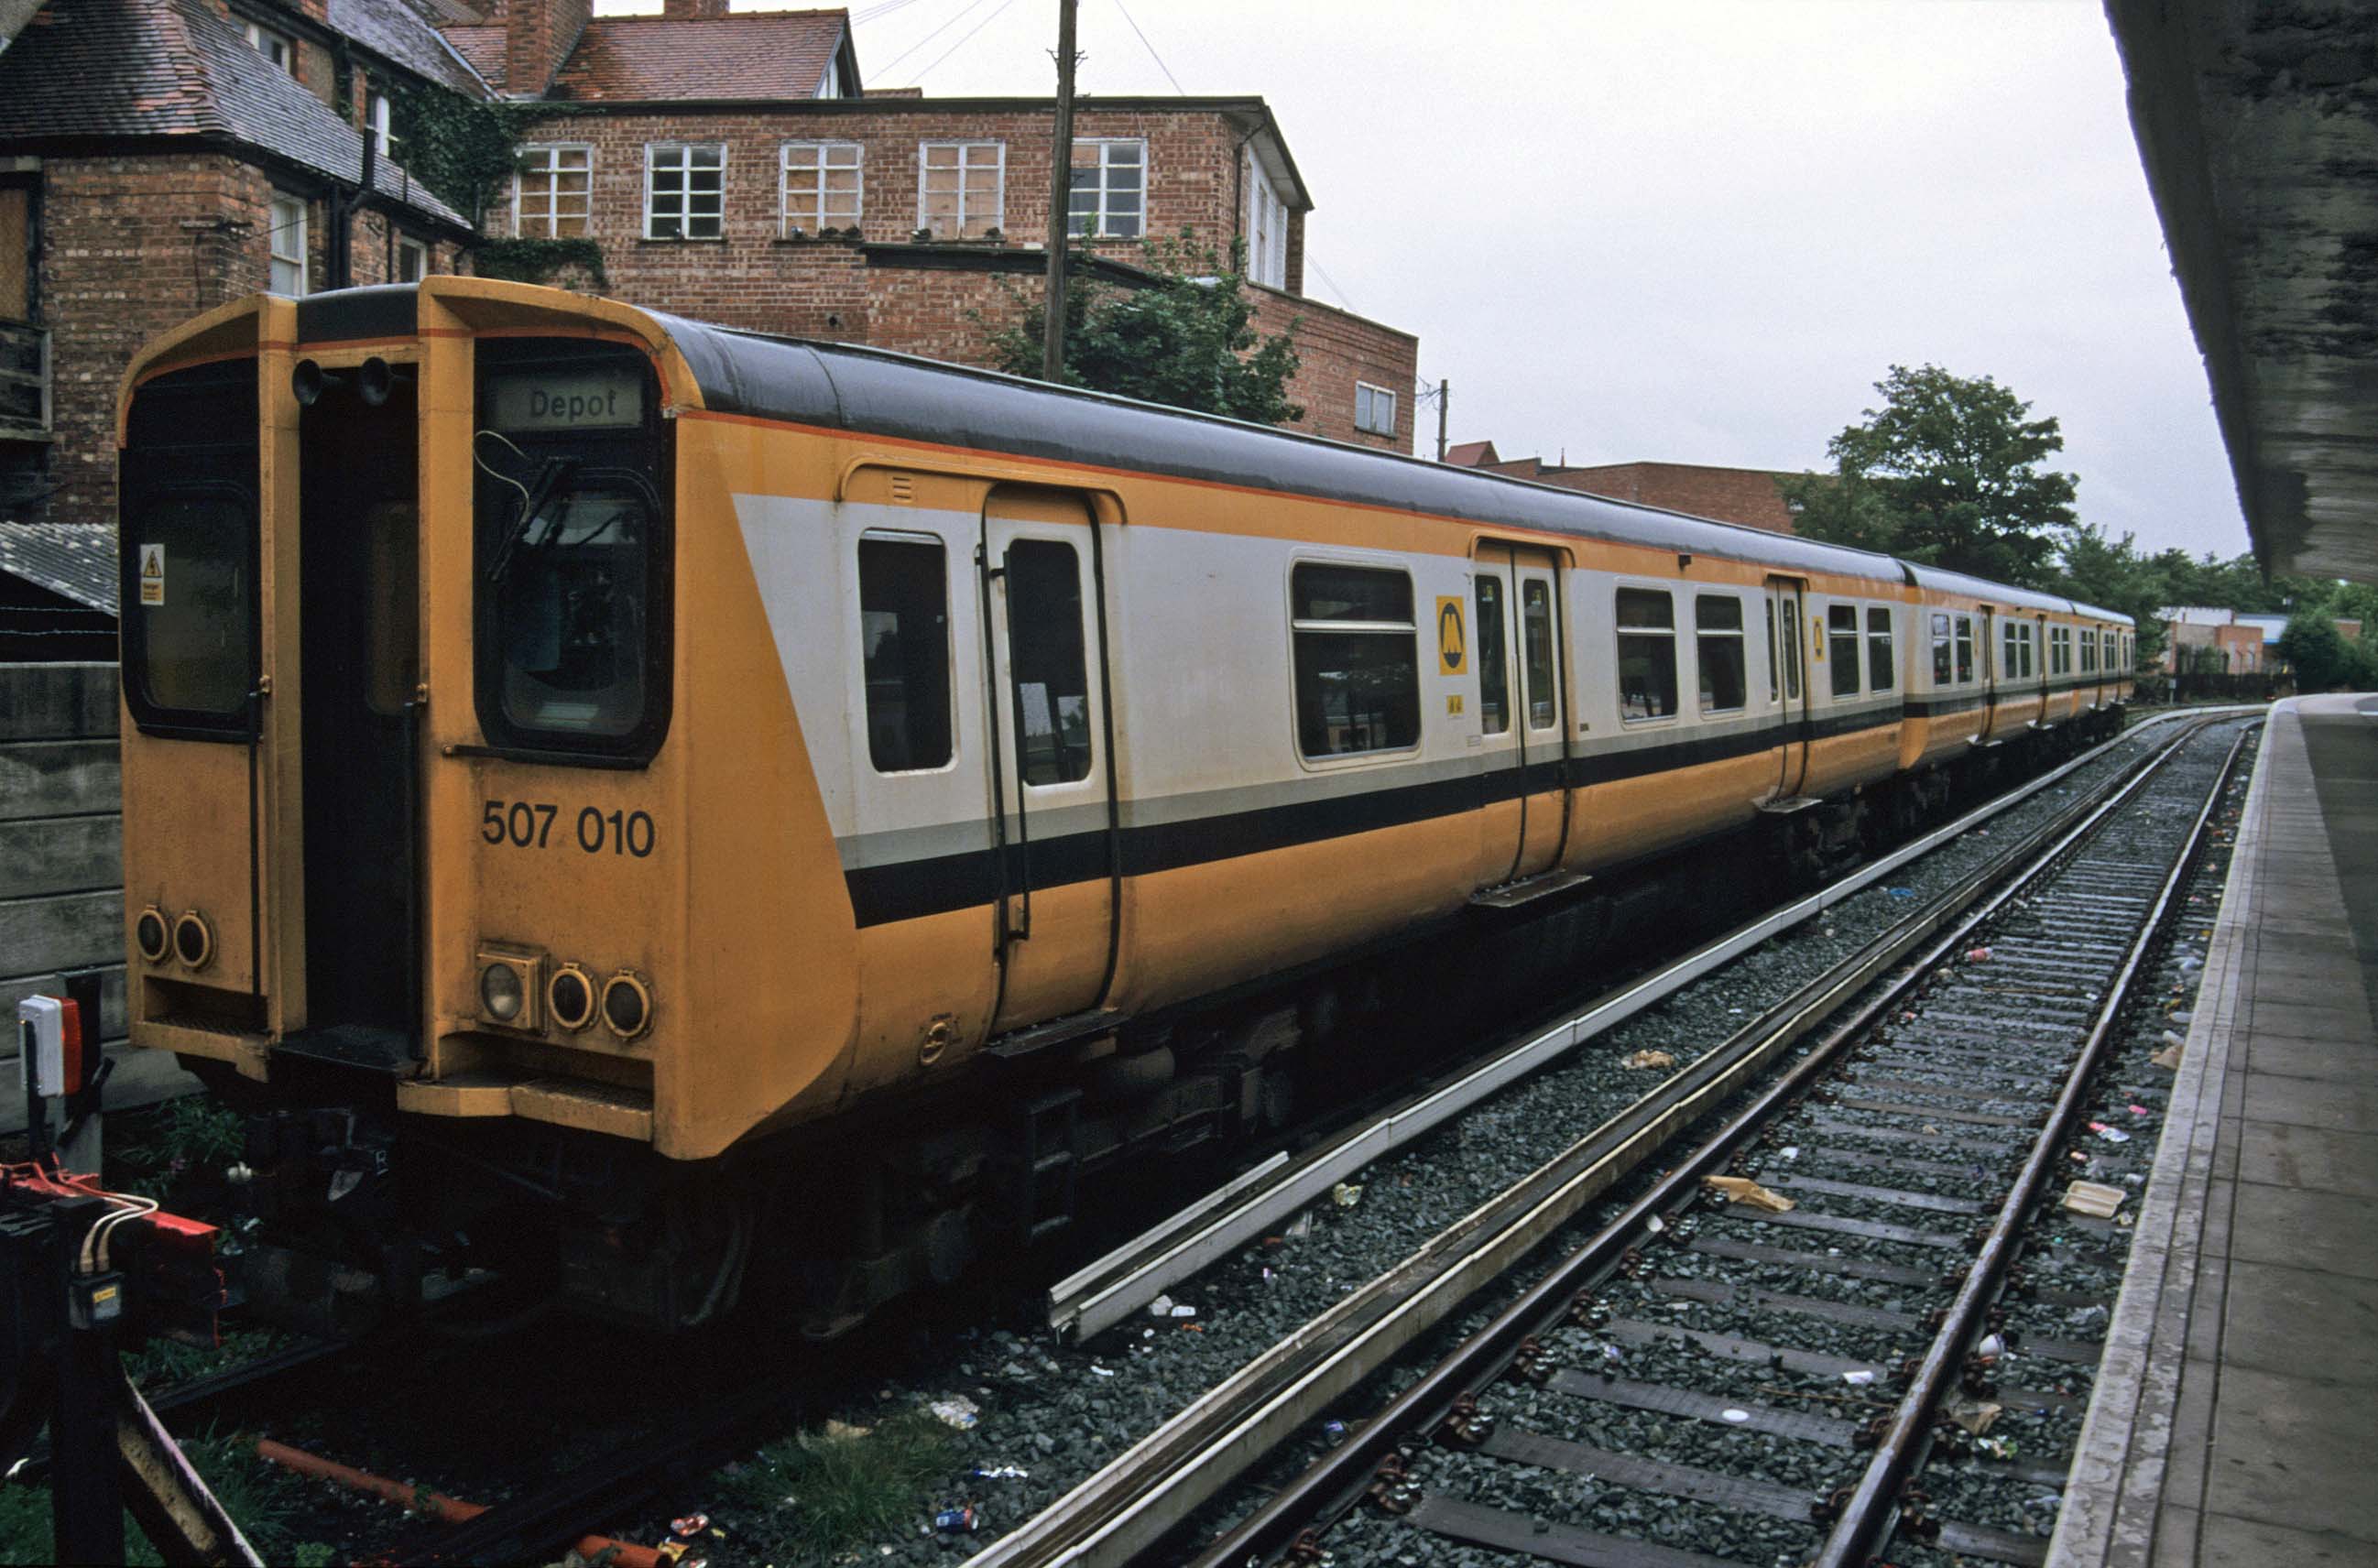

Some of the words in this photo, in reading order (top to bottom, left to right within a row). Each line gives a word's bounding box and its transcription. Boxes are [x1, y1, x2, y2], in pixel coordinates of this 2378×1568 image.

[529, 388, 616, 422] Depot
[483, 800, 558, 849] 507
[577, 806, 655, 858] 010
